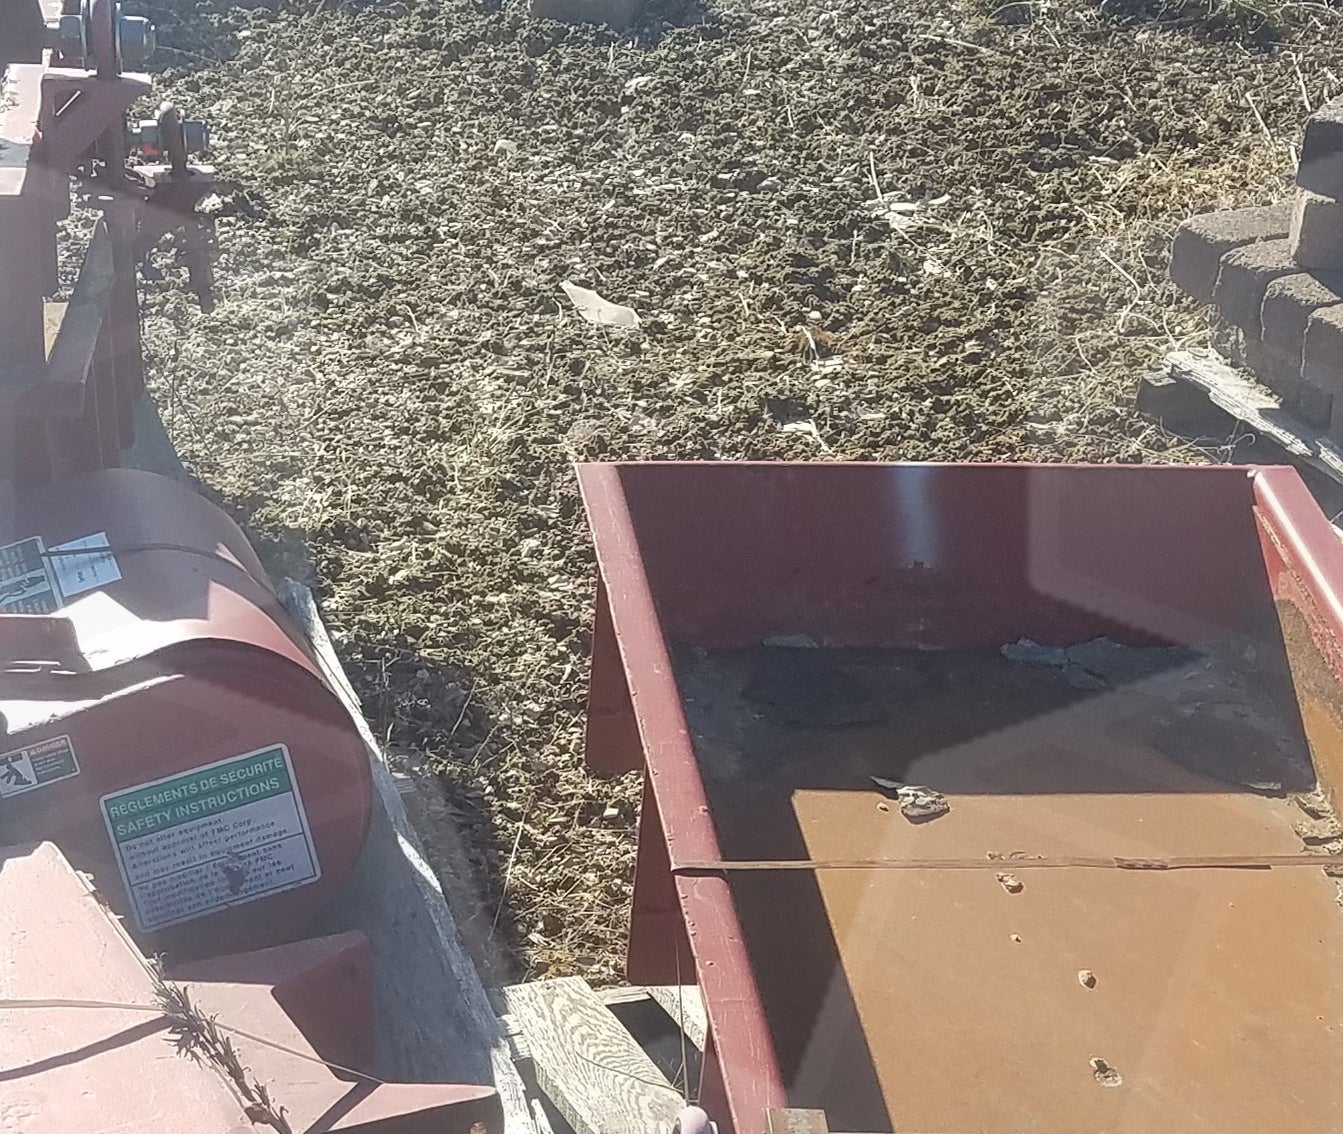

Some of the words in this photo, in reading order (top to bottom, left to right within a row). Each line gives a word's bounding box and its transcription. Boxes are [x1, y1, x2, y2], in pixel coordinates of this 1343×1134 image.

[199, 776, 218, 791] DE
[115, 808, 174, 836] SAFETY
[174, 776, 280, 818] INSTRUCTIONS
